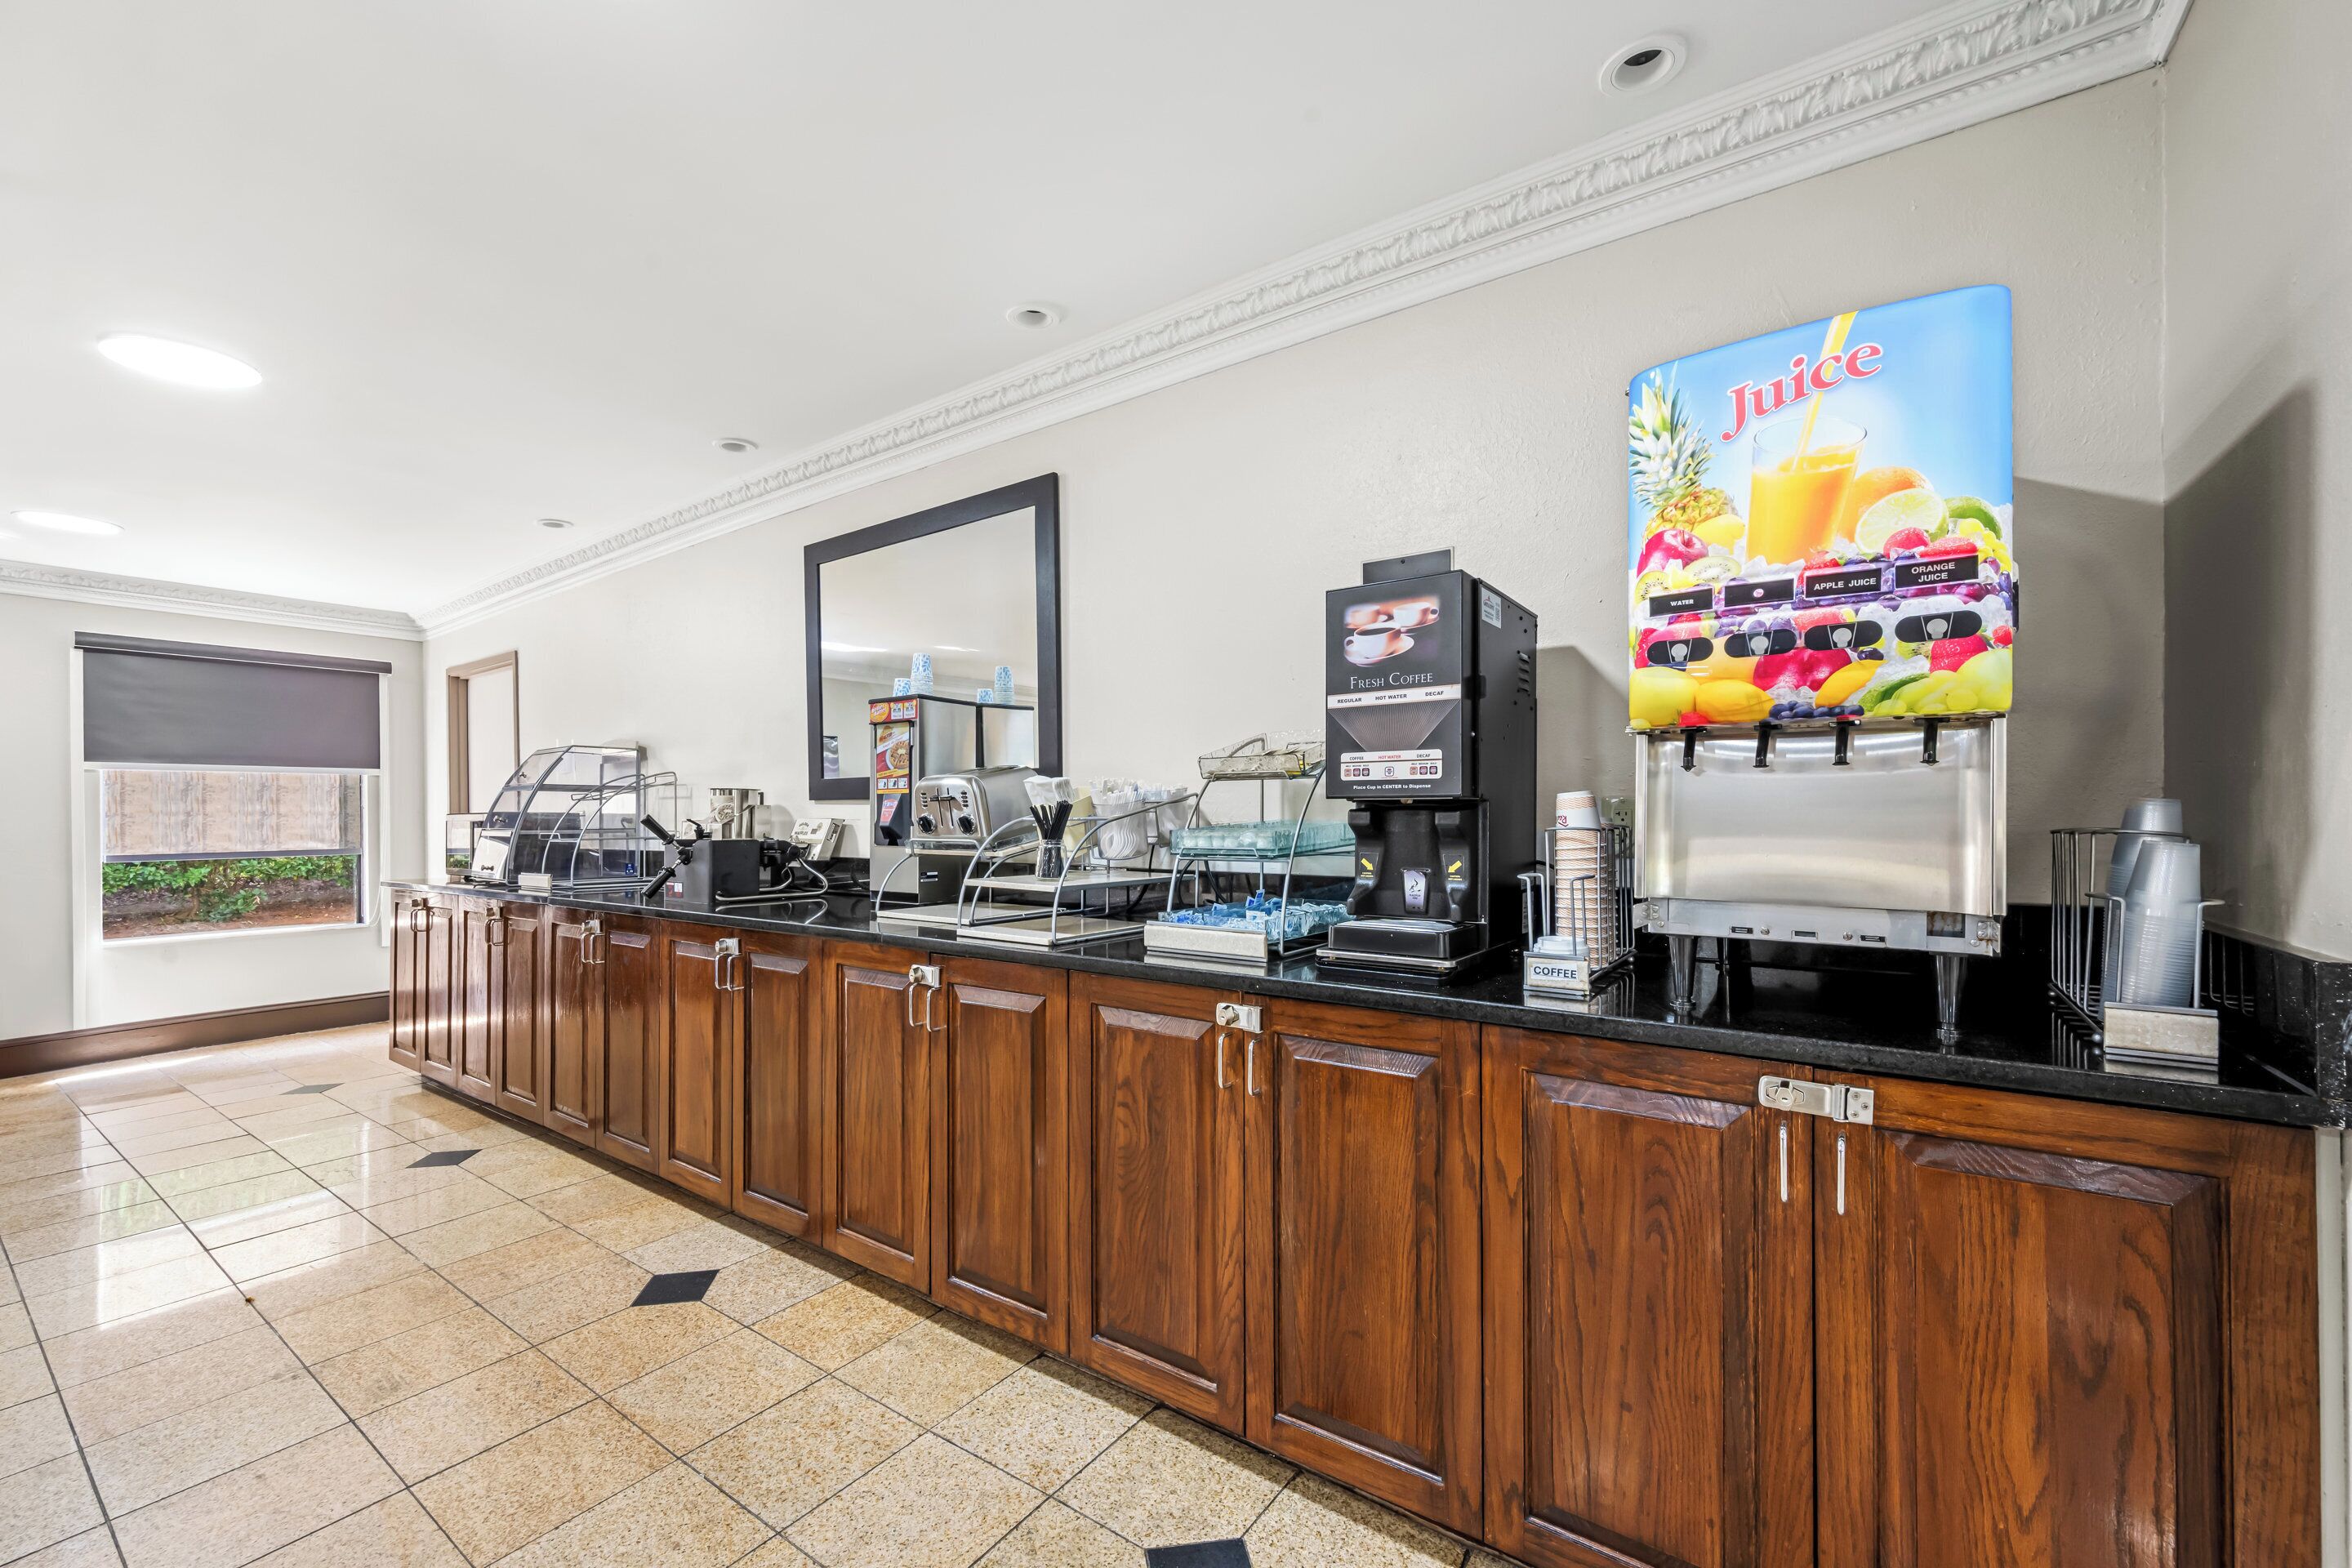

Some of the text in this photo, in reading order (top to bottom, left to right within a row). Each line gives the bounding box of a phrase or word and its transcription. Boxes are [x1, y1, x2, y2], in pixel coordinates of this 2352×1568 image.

[1722, 344, 1882, 442] Juice
[1911, 562, 1956, 574] ORANGE
[1918, 572, 1948, 582] JUICE
[1814, 578, 1877, 590] APPLE JUICE
[1670, 599, 1695, 607] WATER
[1350, 672, 1433, 689] FRESH COFFEE
[1534, 966, 1577, 978] COFFEE
